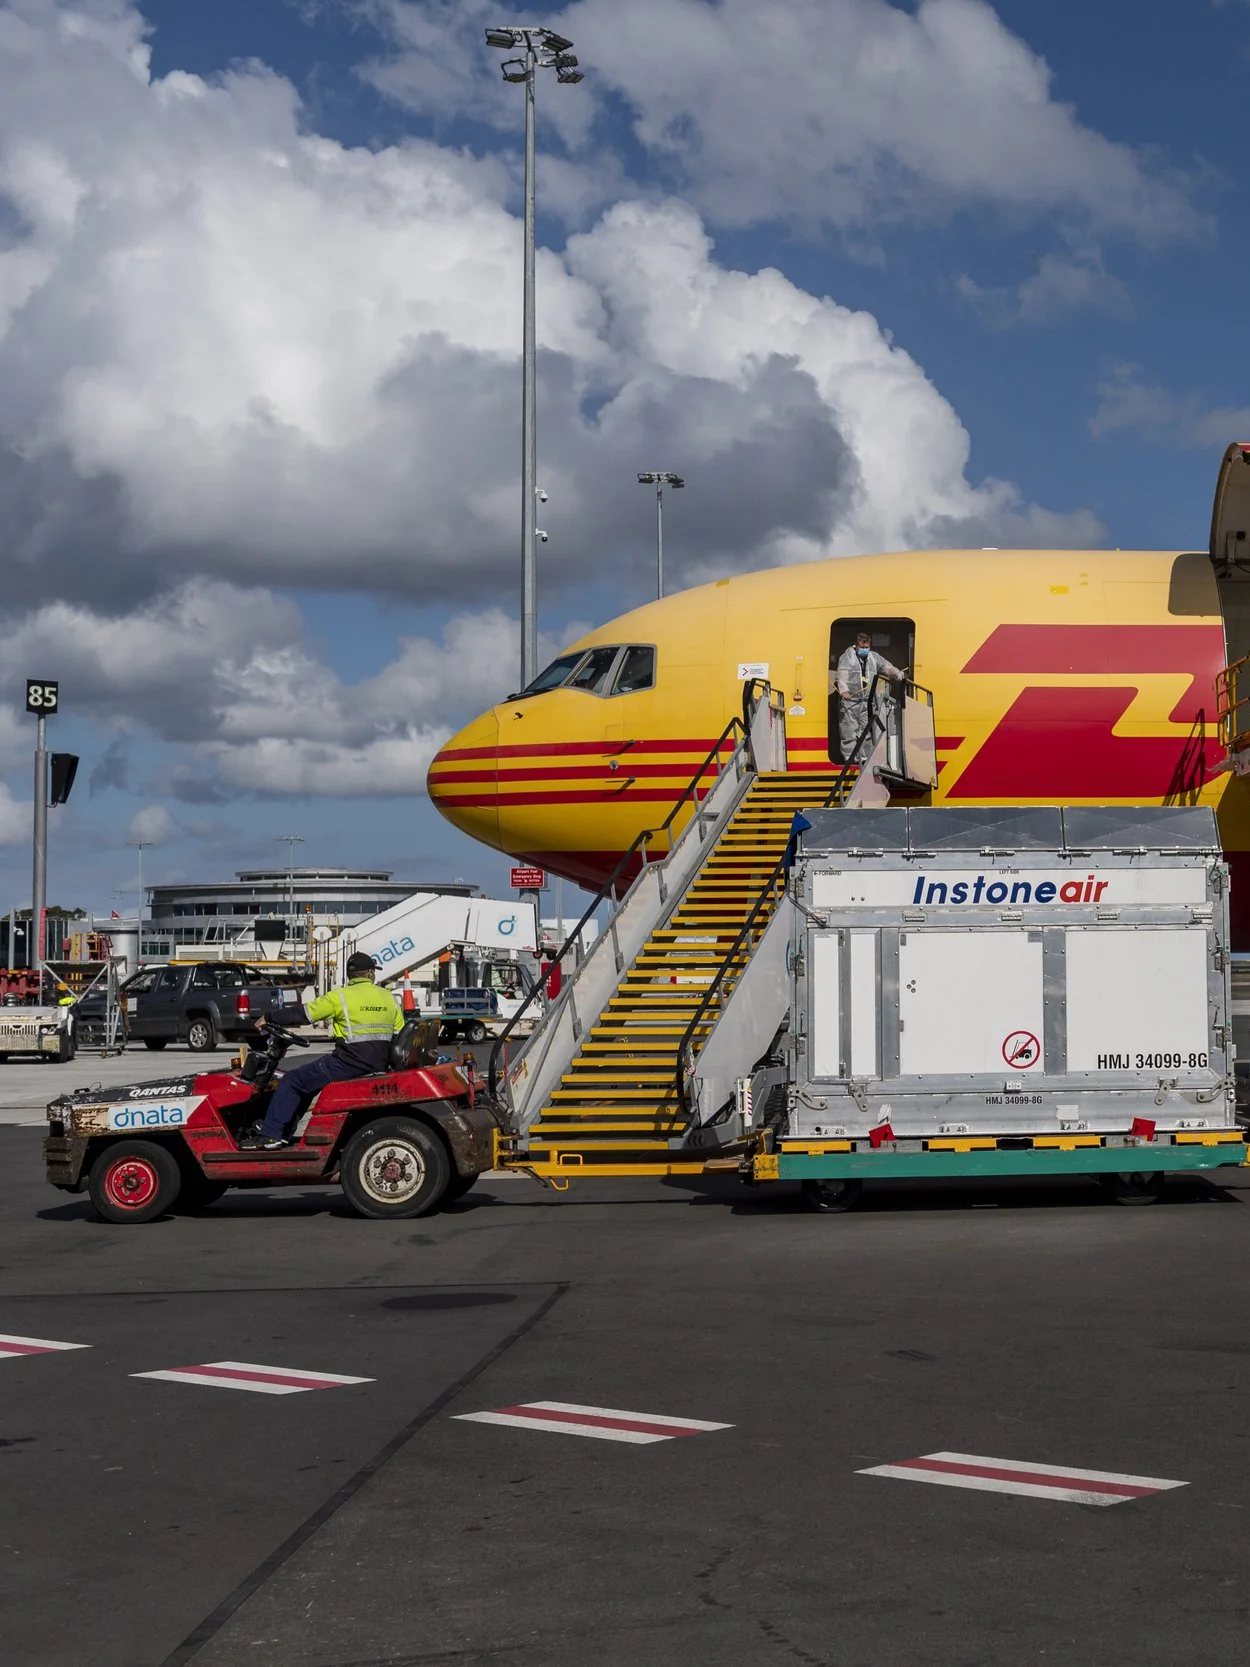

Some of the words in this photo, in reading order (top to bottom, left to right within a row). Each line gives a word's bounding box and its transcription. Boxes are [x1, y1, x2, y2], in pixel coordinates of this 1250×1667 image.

[28, 685, 57, 707] 85
[370, 936, 415, 966] nata
[1097, 1054, 1130, 1070] HMJ
[1135, 1053, 1208, 1069] 34099-8G
[129, 1085, 187, 1097] QANTAS
[985, 1096, 1003, 1105] HMJ
[1005, 1096, 1043, 1105] 34099-8G
[114, 1105, 183, 1127] dnata
